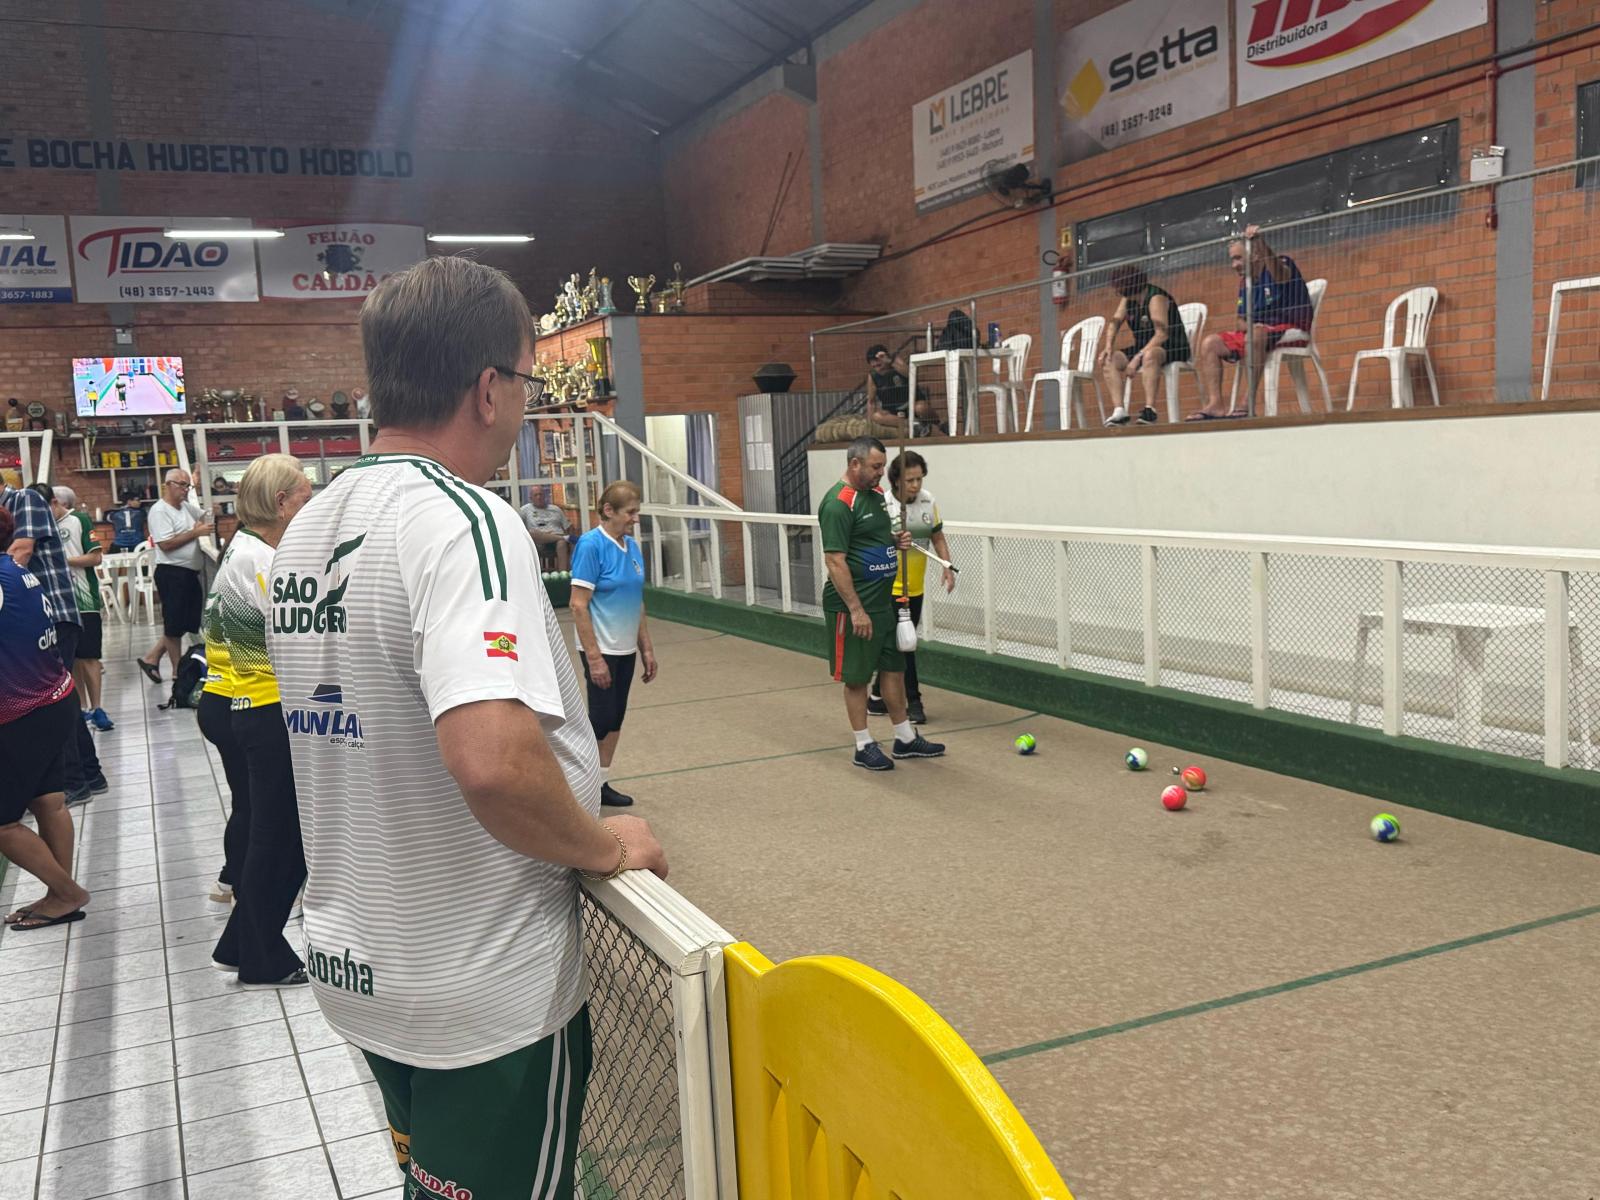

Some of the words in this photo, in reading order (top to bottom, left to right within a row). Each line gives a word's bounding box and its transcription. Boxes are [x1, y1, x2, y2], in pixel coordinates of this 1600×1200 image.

[1247, 18, 1328, 59] Distribuidora
[1109, 25, 1218, 93] Setta
[950, 69, 1009, 123] LEBRE
[27, 139, 136, 171] BOCHA
[147, 142, 289, 174] HUBERTO
[307, 229, 376, 245] FEIJÃO
[119, 287, 144, 298] (48)
[149, 286, 215, 297] 3657-1443
[292, 270, 391, 291] CALDÃ
[123, 511, 132, 527] 1
[273, 572, 318, 604] SÃO
[308, 942, 374, 997] Bocha
